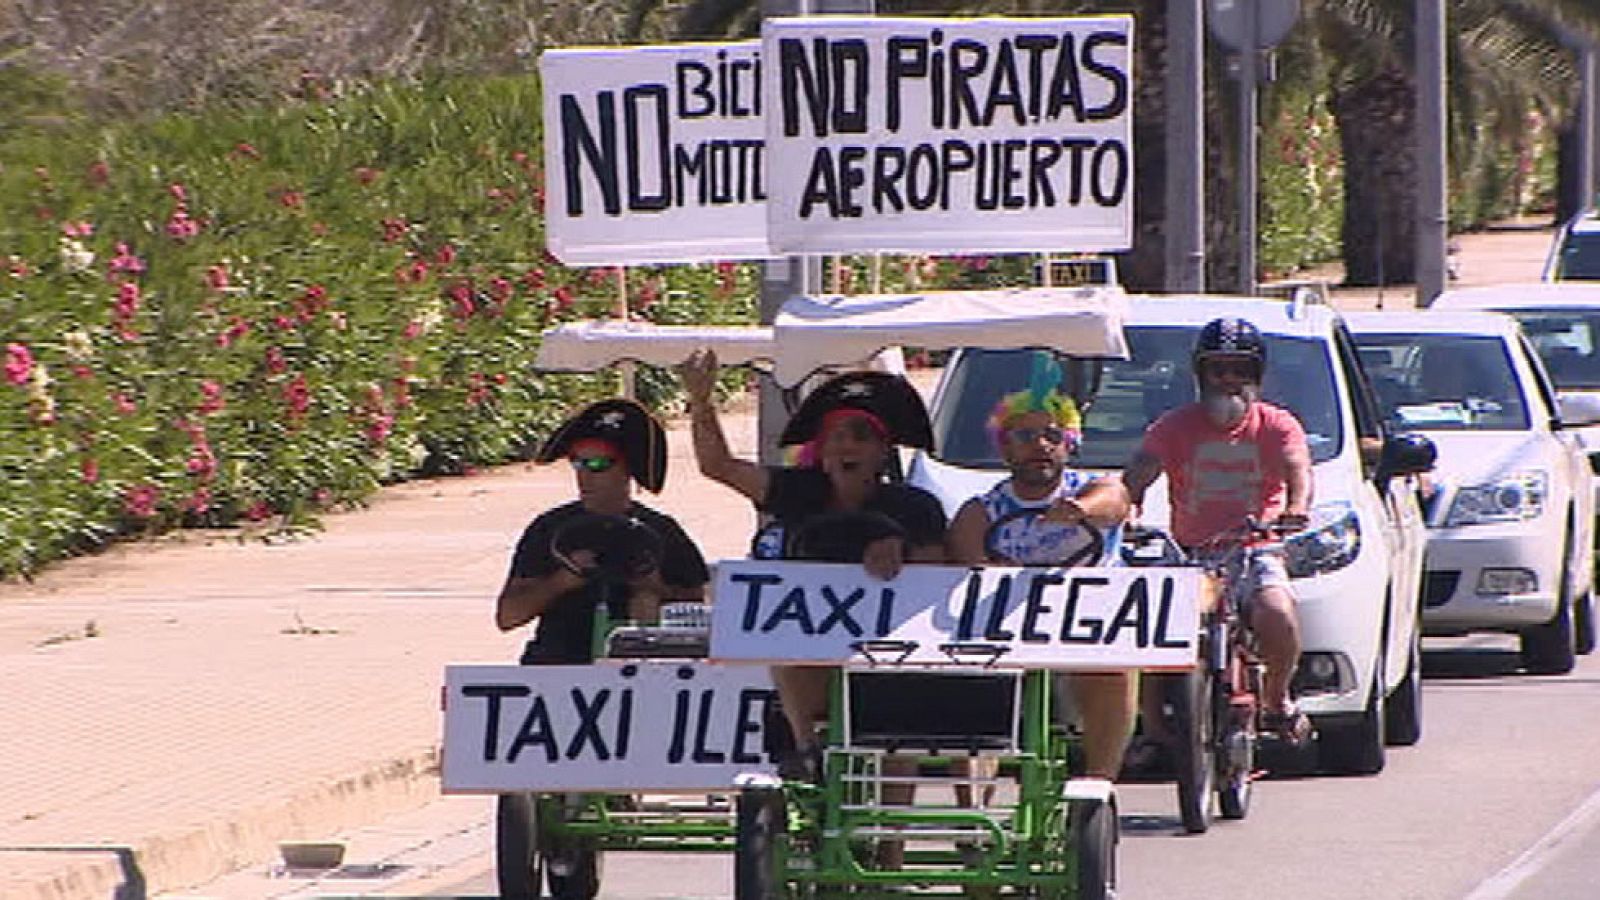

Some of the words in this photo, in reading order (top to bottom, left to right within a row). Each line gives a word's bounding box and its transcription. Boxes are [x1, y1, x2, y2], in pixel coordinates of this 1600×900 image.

[779, 37, 868, 137] NO
[560, 84, 672, 217] NO
[800, 138, 1129, 219] AEROPUERTO
